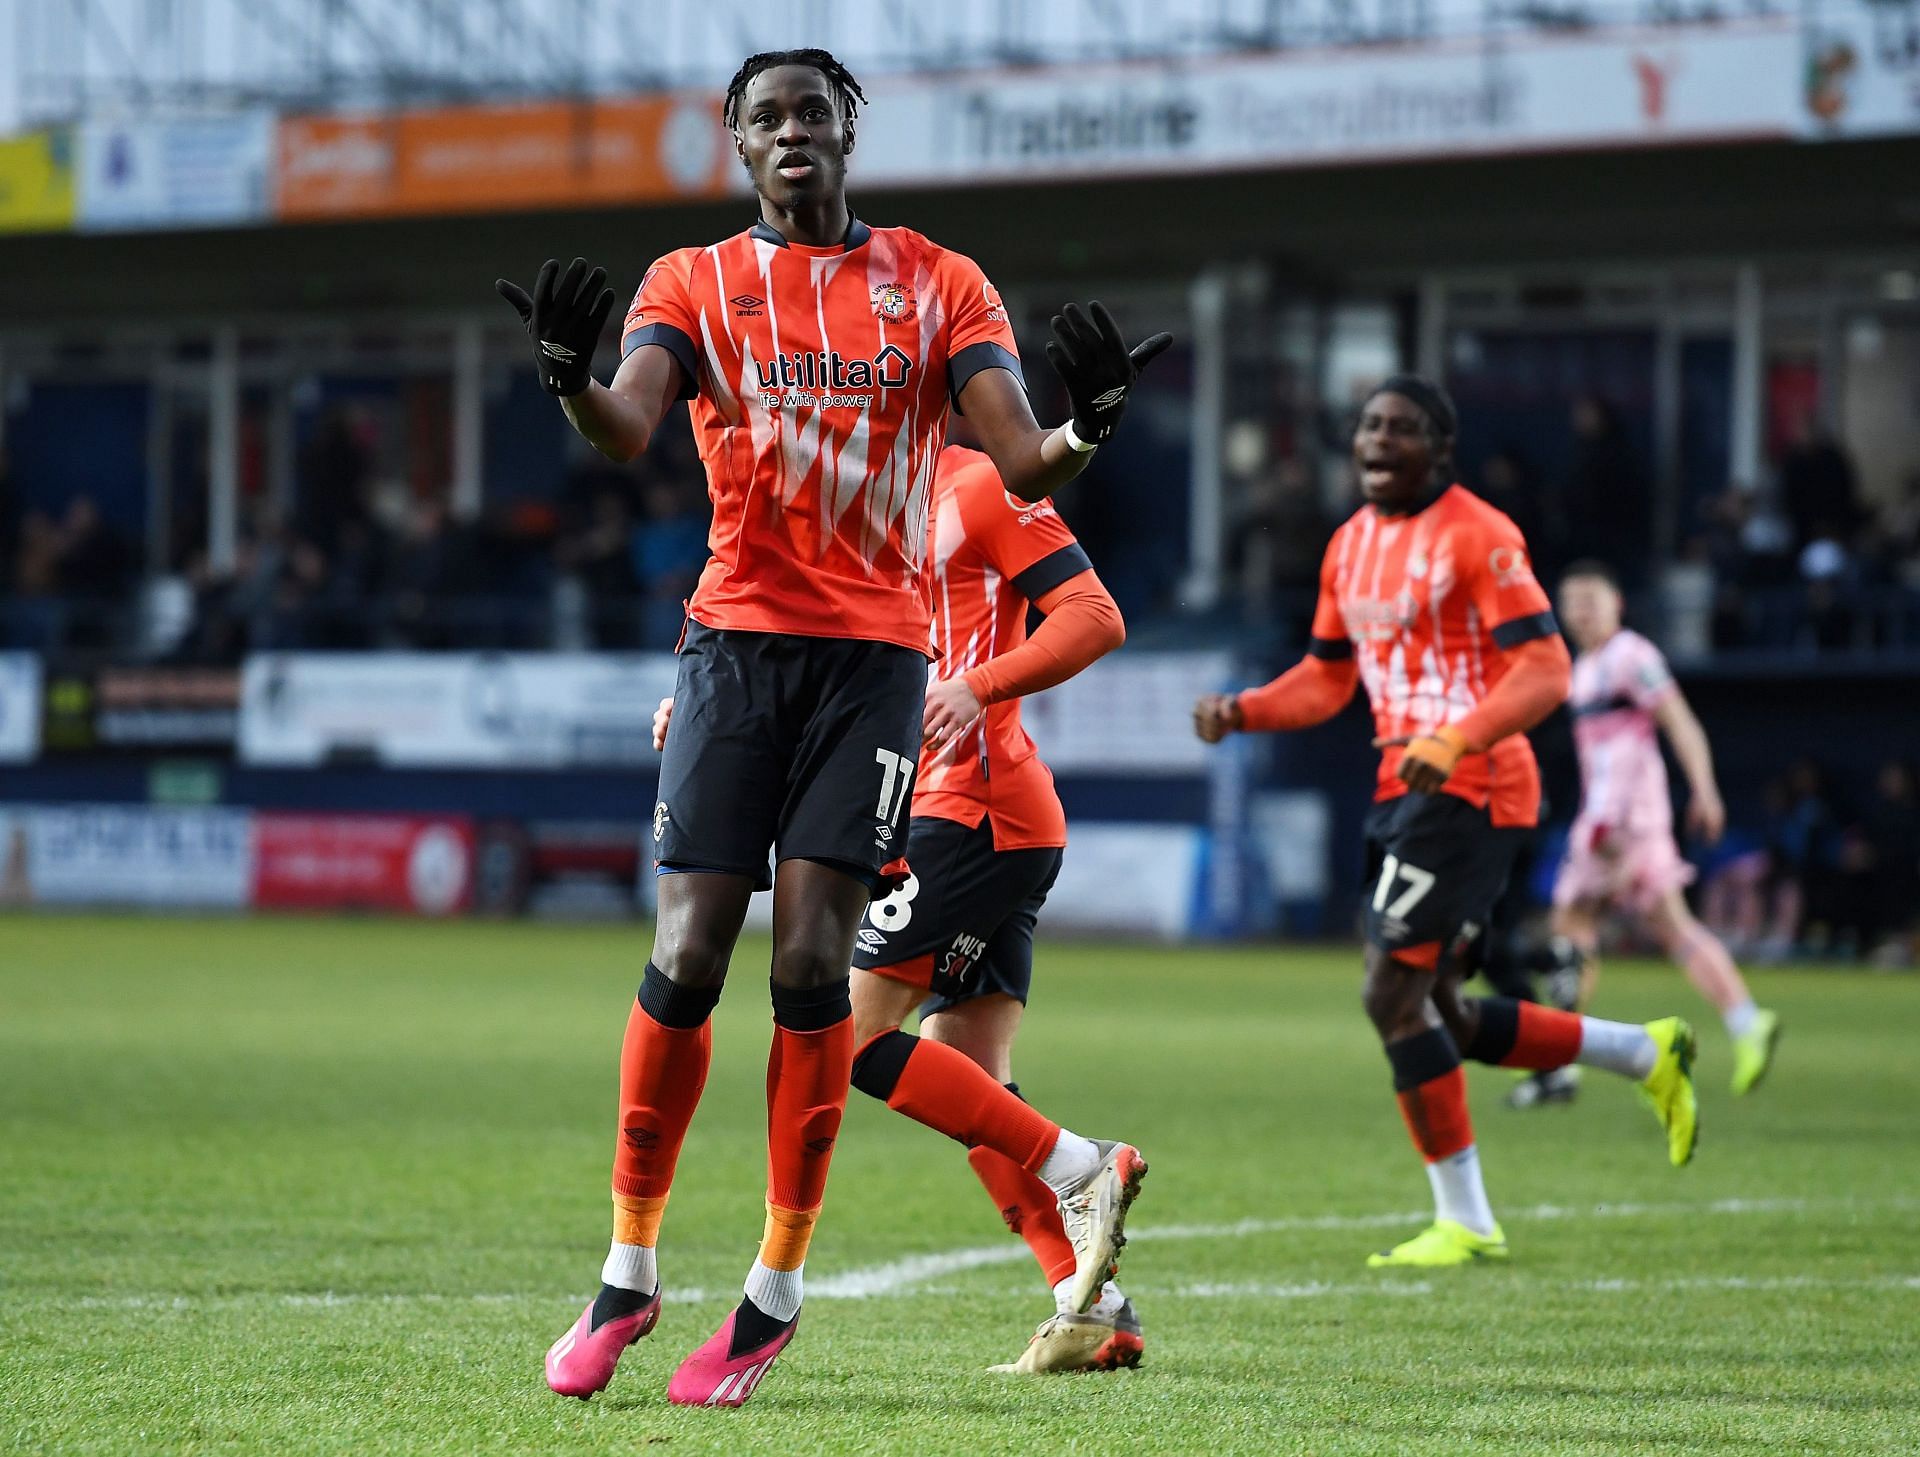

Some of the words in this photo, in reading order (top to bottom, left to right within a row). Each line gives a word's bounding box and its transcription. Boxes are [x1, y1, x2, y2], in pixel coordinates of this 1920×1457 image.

[736, 309, 763, 317] umbro
[542, 348, 572, 364] umbro
[755, 351, 873, 389] utilita
[758, 391, 780, 407] life
[783, 391, 817, 407] with
[821, 394, 873, 410] power
[1095, 395, 1124, 412] umbro
[876, 747, 914, 829] 11
[1372, 854, 1436, 920] 17
[861, 872, 920, 932] 8
[855, 940, 879, 955] umbro
[951, 931, 987, 961] MUS
